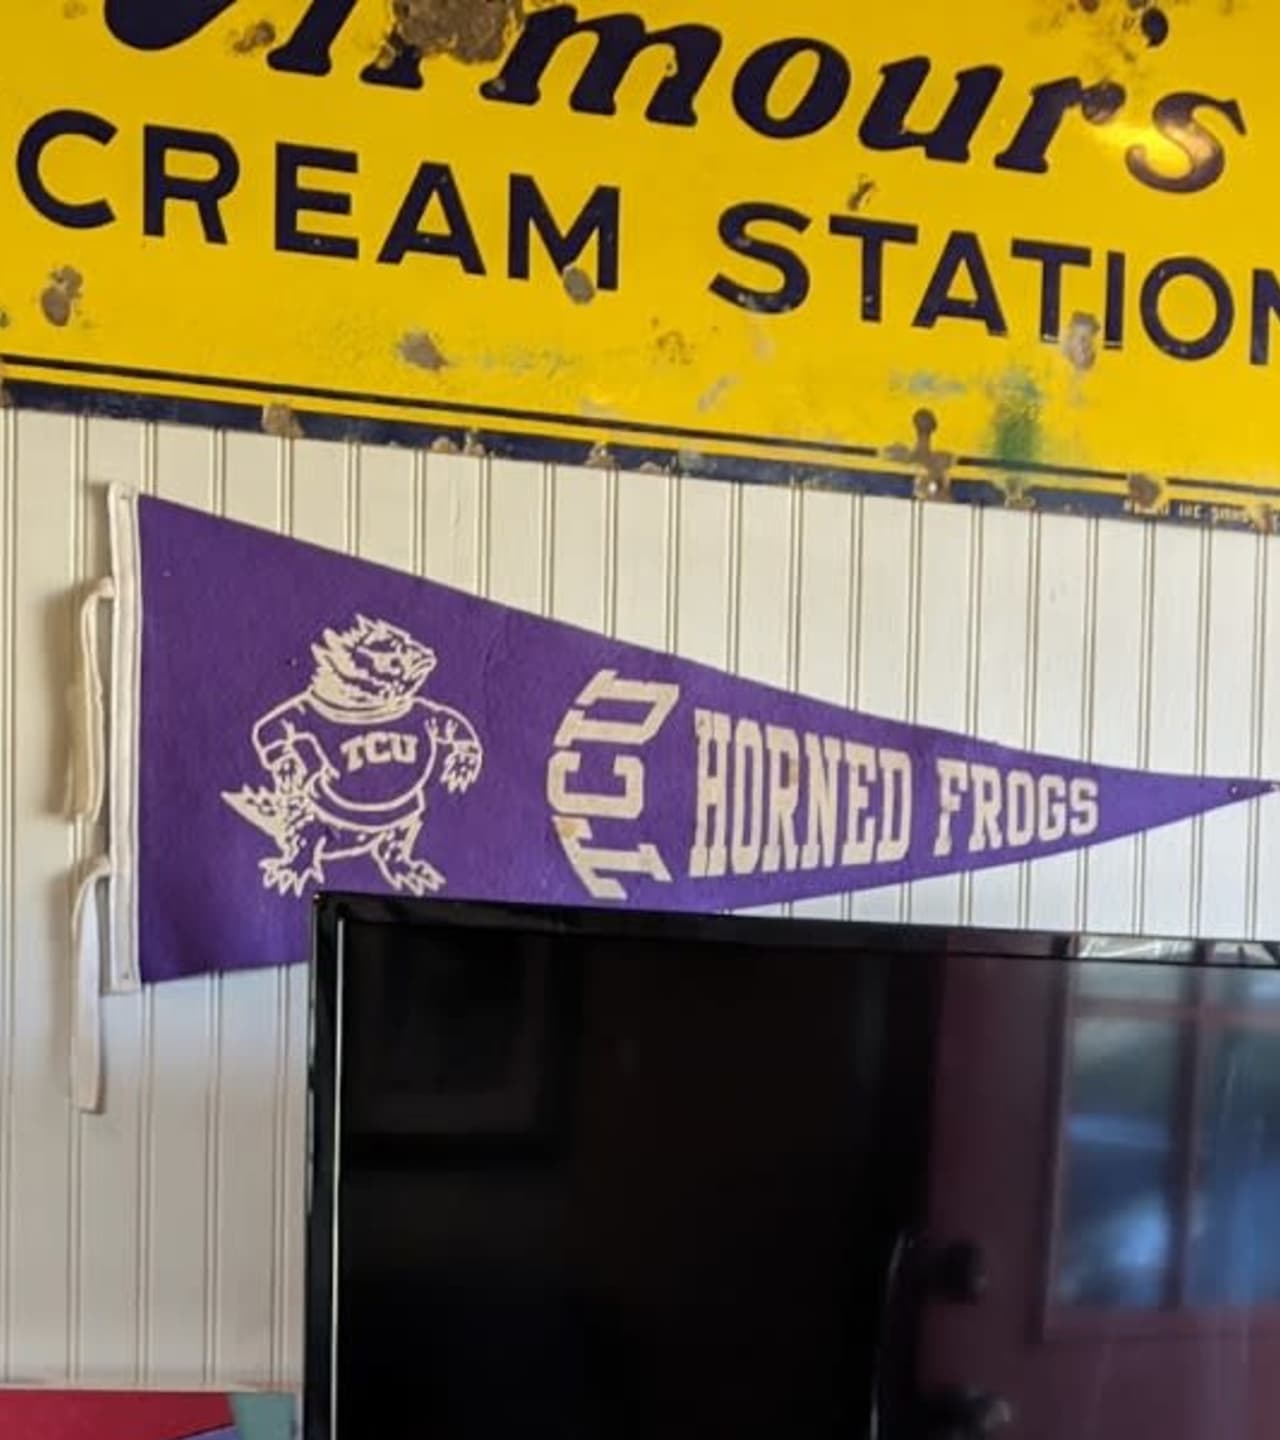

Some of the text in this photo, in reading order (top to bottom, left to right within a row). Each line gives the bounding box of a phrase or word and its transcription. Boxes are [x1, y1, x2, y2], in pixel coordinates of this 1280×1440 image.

[103, 0, 1247, 194] mour's
[16, 109, 620, 290] CREAM
[339, 731, 419, 772] TCU
[546, 668, 681, 901] TCU
[691, 708, 1099, 879] HORNED FROGS
